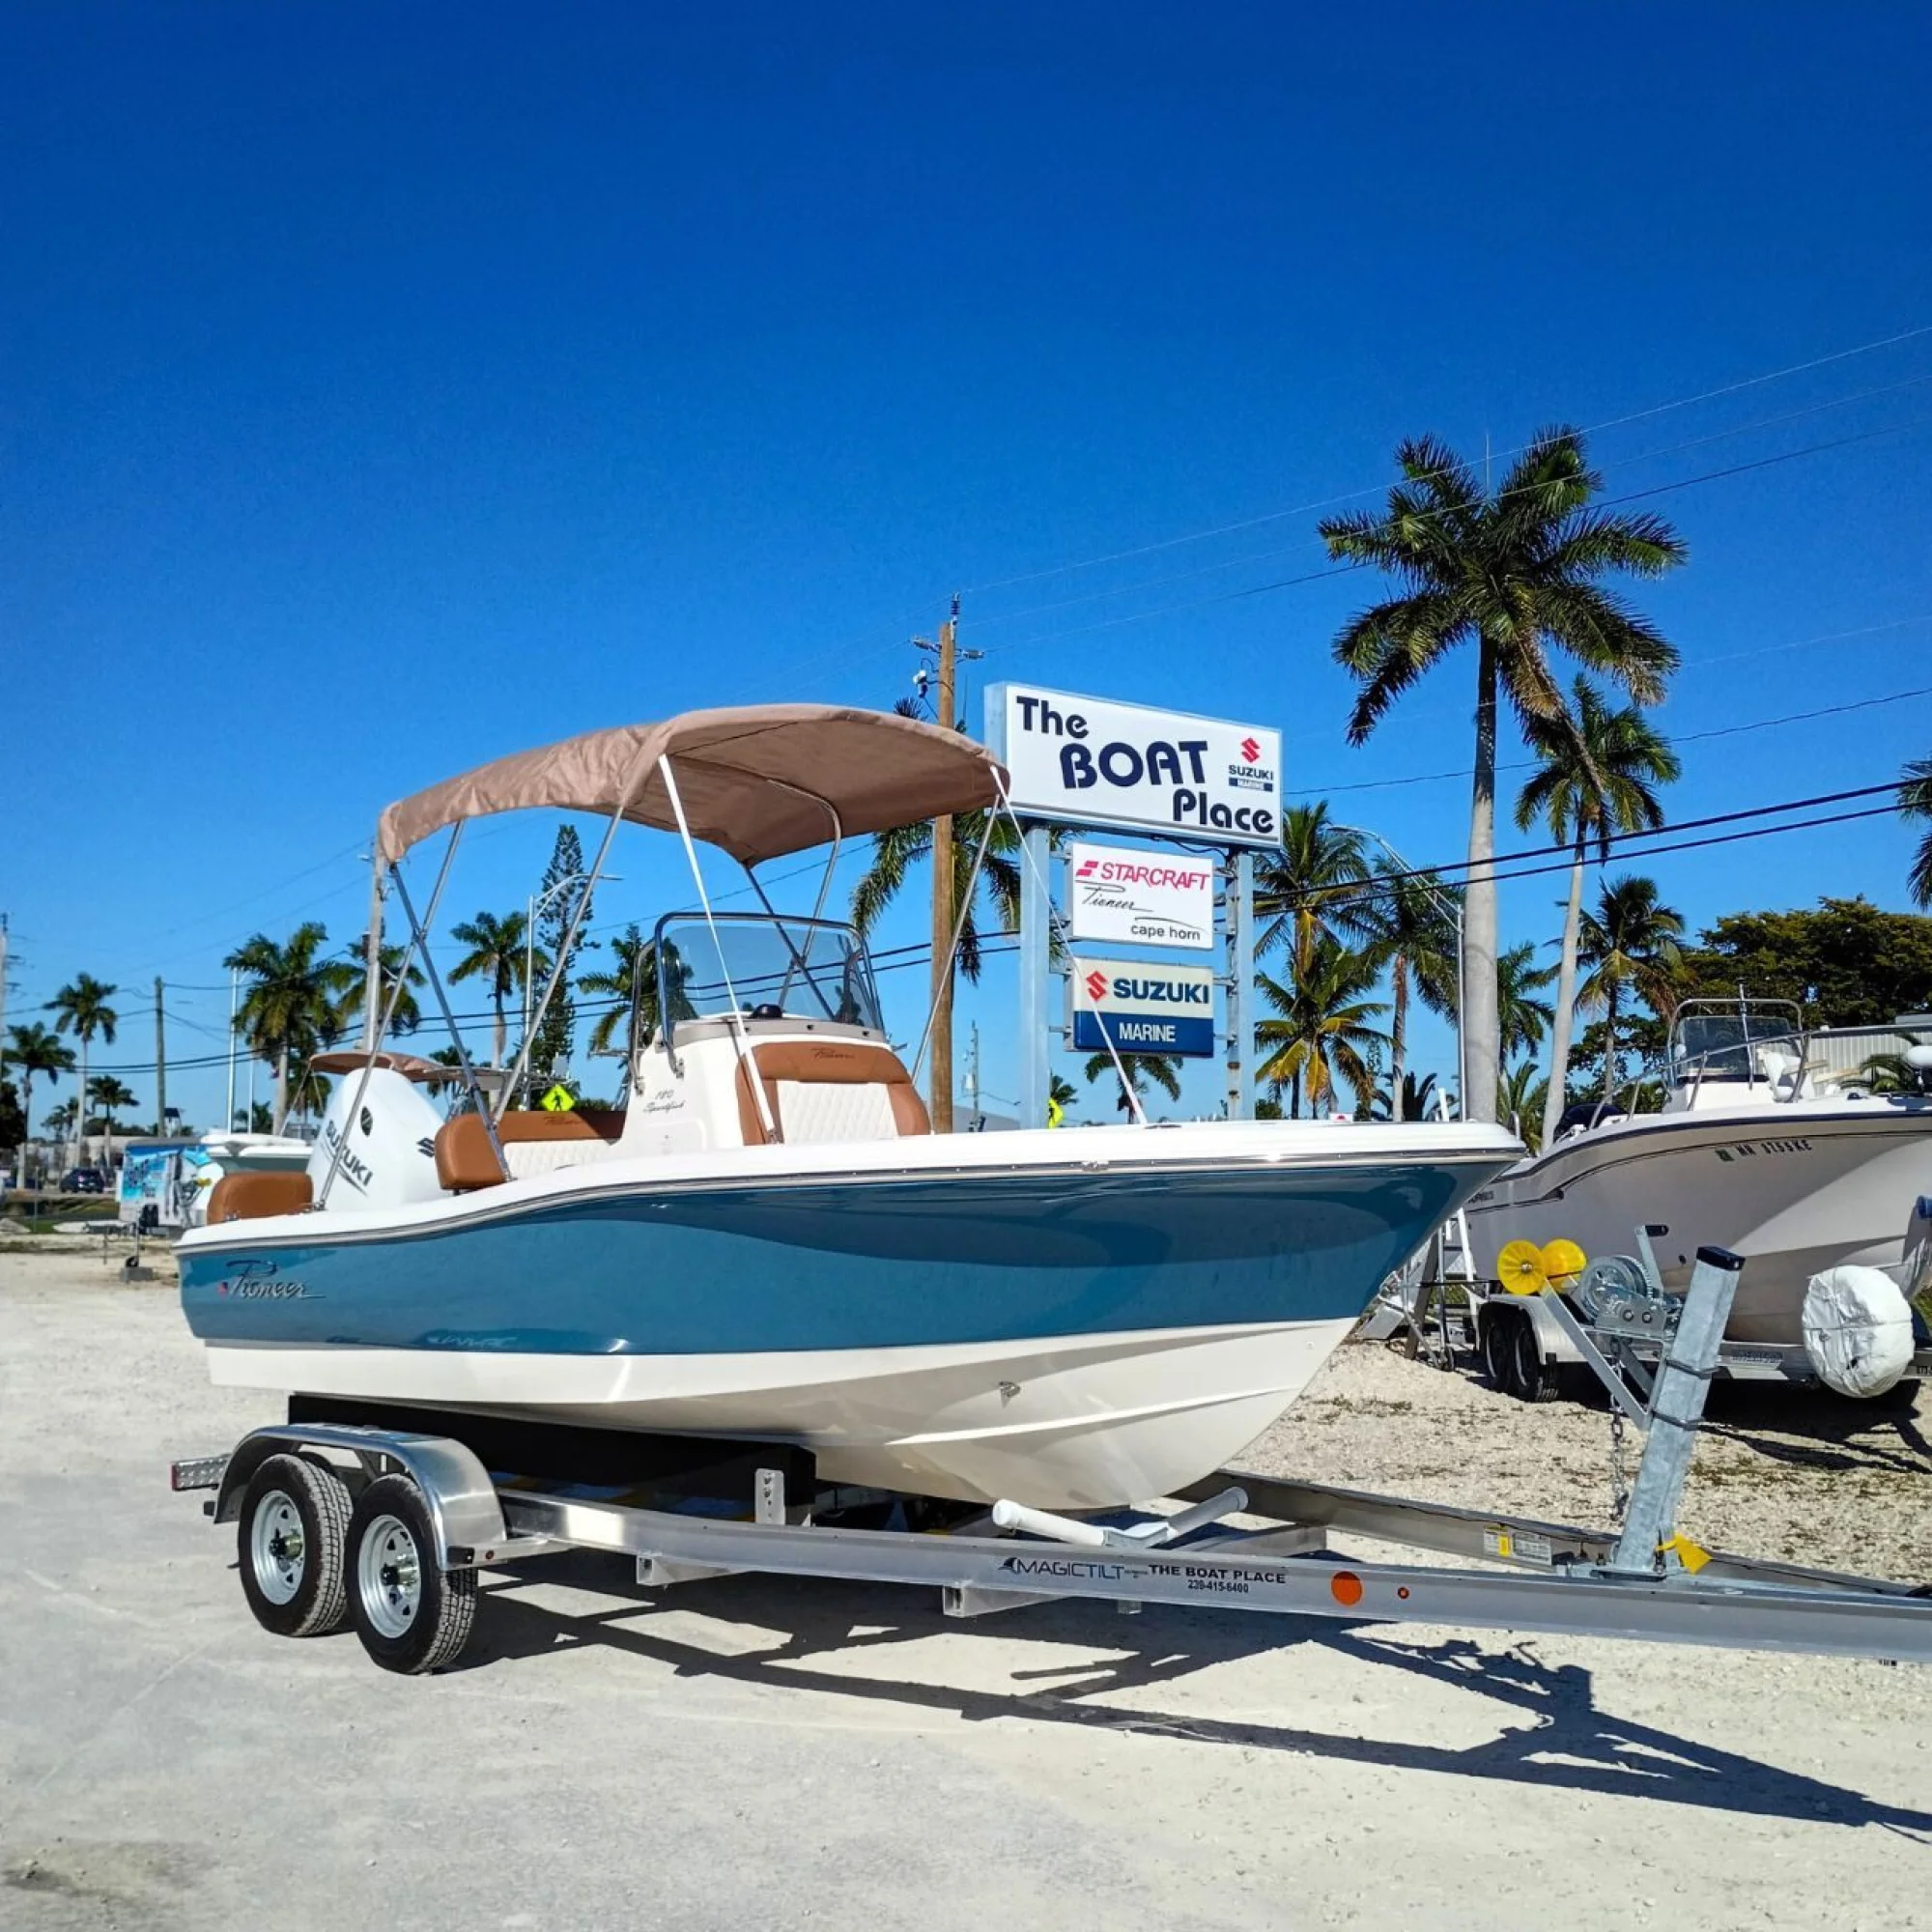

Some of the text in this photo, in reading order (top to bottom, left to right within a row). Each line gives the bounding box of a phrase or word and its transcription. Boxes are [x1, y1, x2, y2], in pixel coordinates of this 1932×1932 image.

[1016, 696, 1089, 739] The
[1060, 740, 1208, 789] BOAT
[1228, 764, 1274, 781] SUZUKI
[1173, 788, 1274, 834] Place
[1100, 862, 1210, 891] STARCRAFT
[1074, 880, 1153, 912] Pioneer
[1130, 923, 1201, 940] cape horn
[1113, 978, 1209, 1004] SUZUKI
[1119, 1023, 1176, 1042] MARINE
[226, 1260, 327, 1300] Pioneer
[1015, 1558, 1287, 1584] MAGICTILT THE BOAT PLACE
[1187, 1579, 1249, 1593] 239-415-6400
